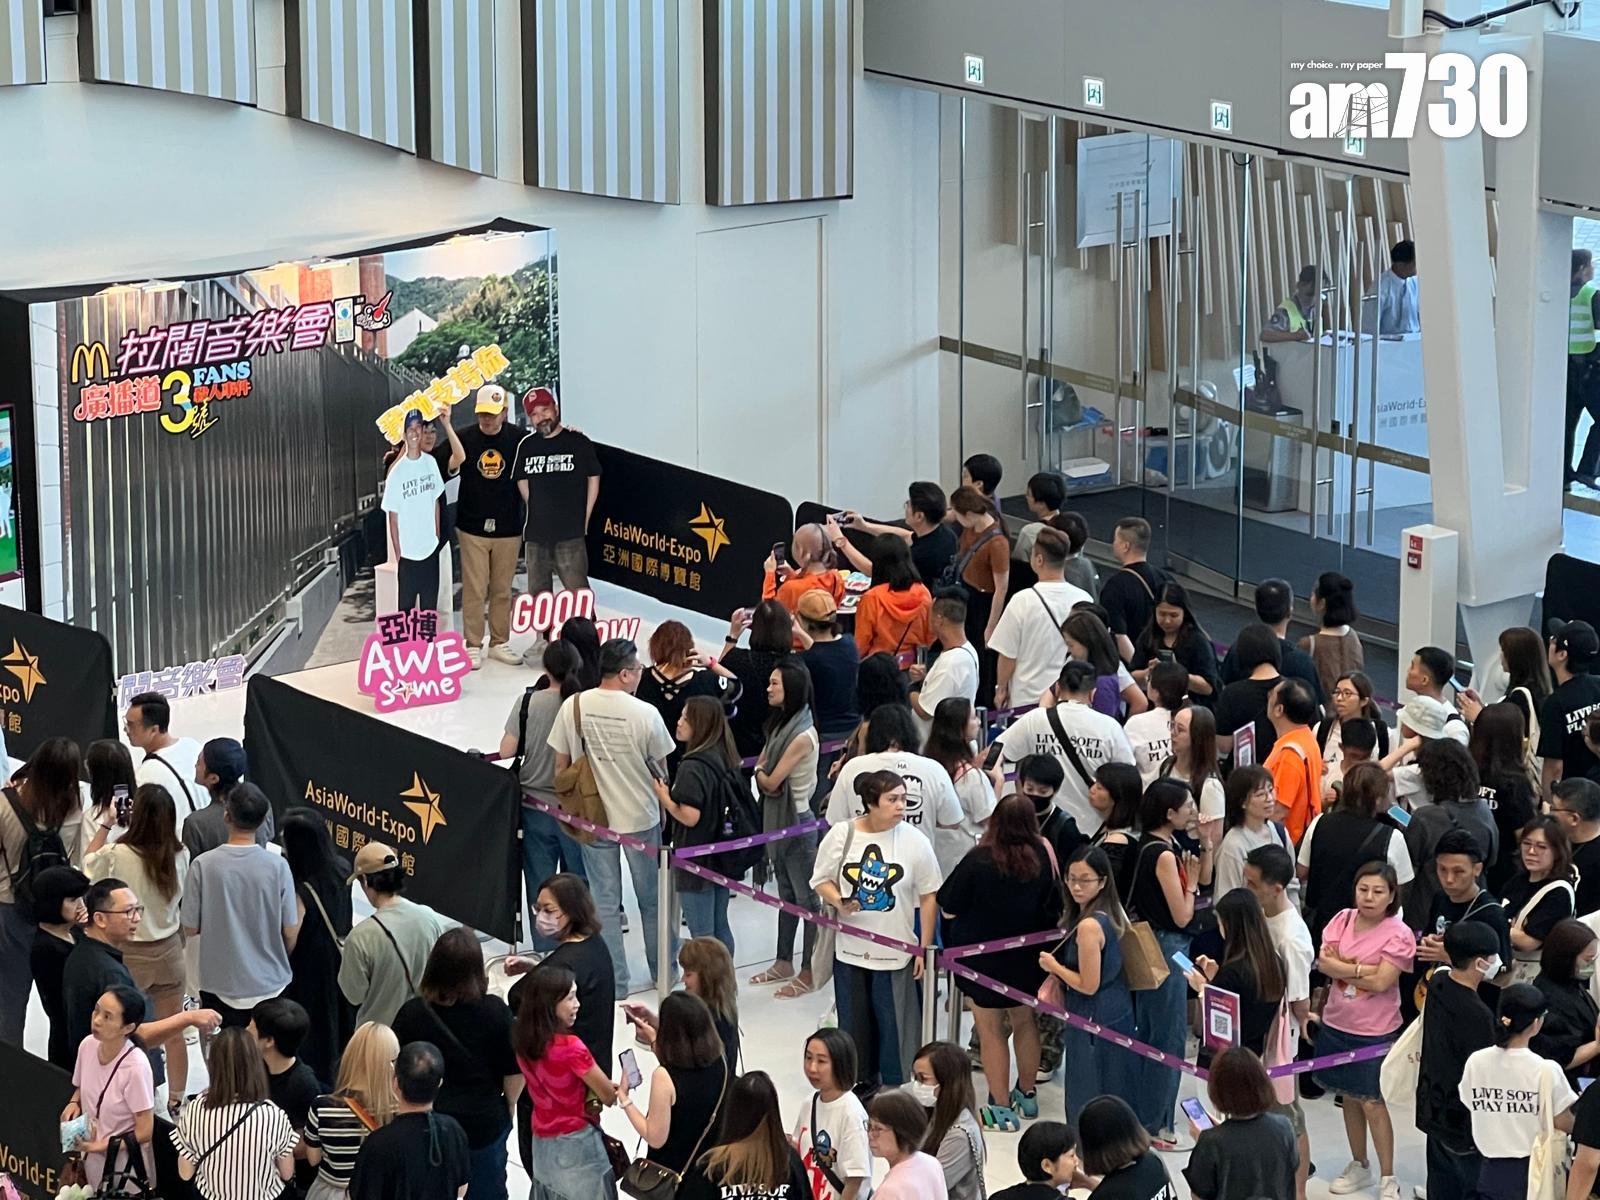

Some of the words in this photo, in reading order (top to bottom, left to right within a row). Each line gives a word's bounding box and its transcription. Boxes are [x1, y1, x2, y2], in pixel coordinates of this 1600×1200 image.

[116, 301, 334, 376] 拉闊音樂會
[193, 361, 250, 386] FANS
[603, 517, 701, 563] AsiaWorld-Expo
[512, 589, 594, 632] GOOD
[378, 610, 438, 645] 亞博
[364, 639, 466, 686] AWE
[1566, 719, 1587, 734] PLA
[1036, 734, 1060, 744] LIV
[1070, 736, 1103, 748] SOFT
[1148, 739, 1171, 751] LIV
[1078, 748, 1103, 759] ARD
[1148, 751, 1173, 762] PLA
[305, 779, 416, 843] AsiaWorld-Expo
[1472, 1087, 1503, 1100] LIVE
[1472, 1101, 1503, 1112] PLAY
